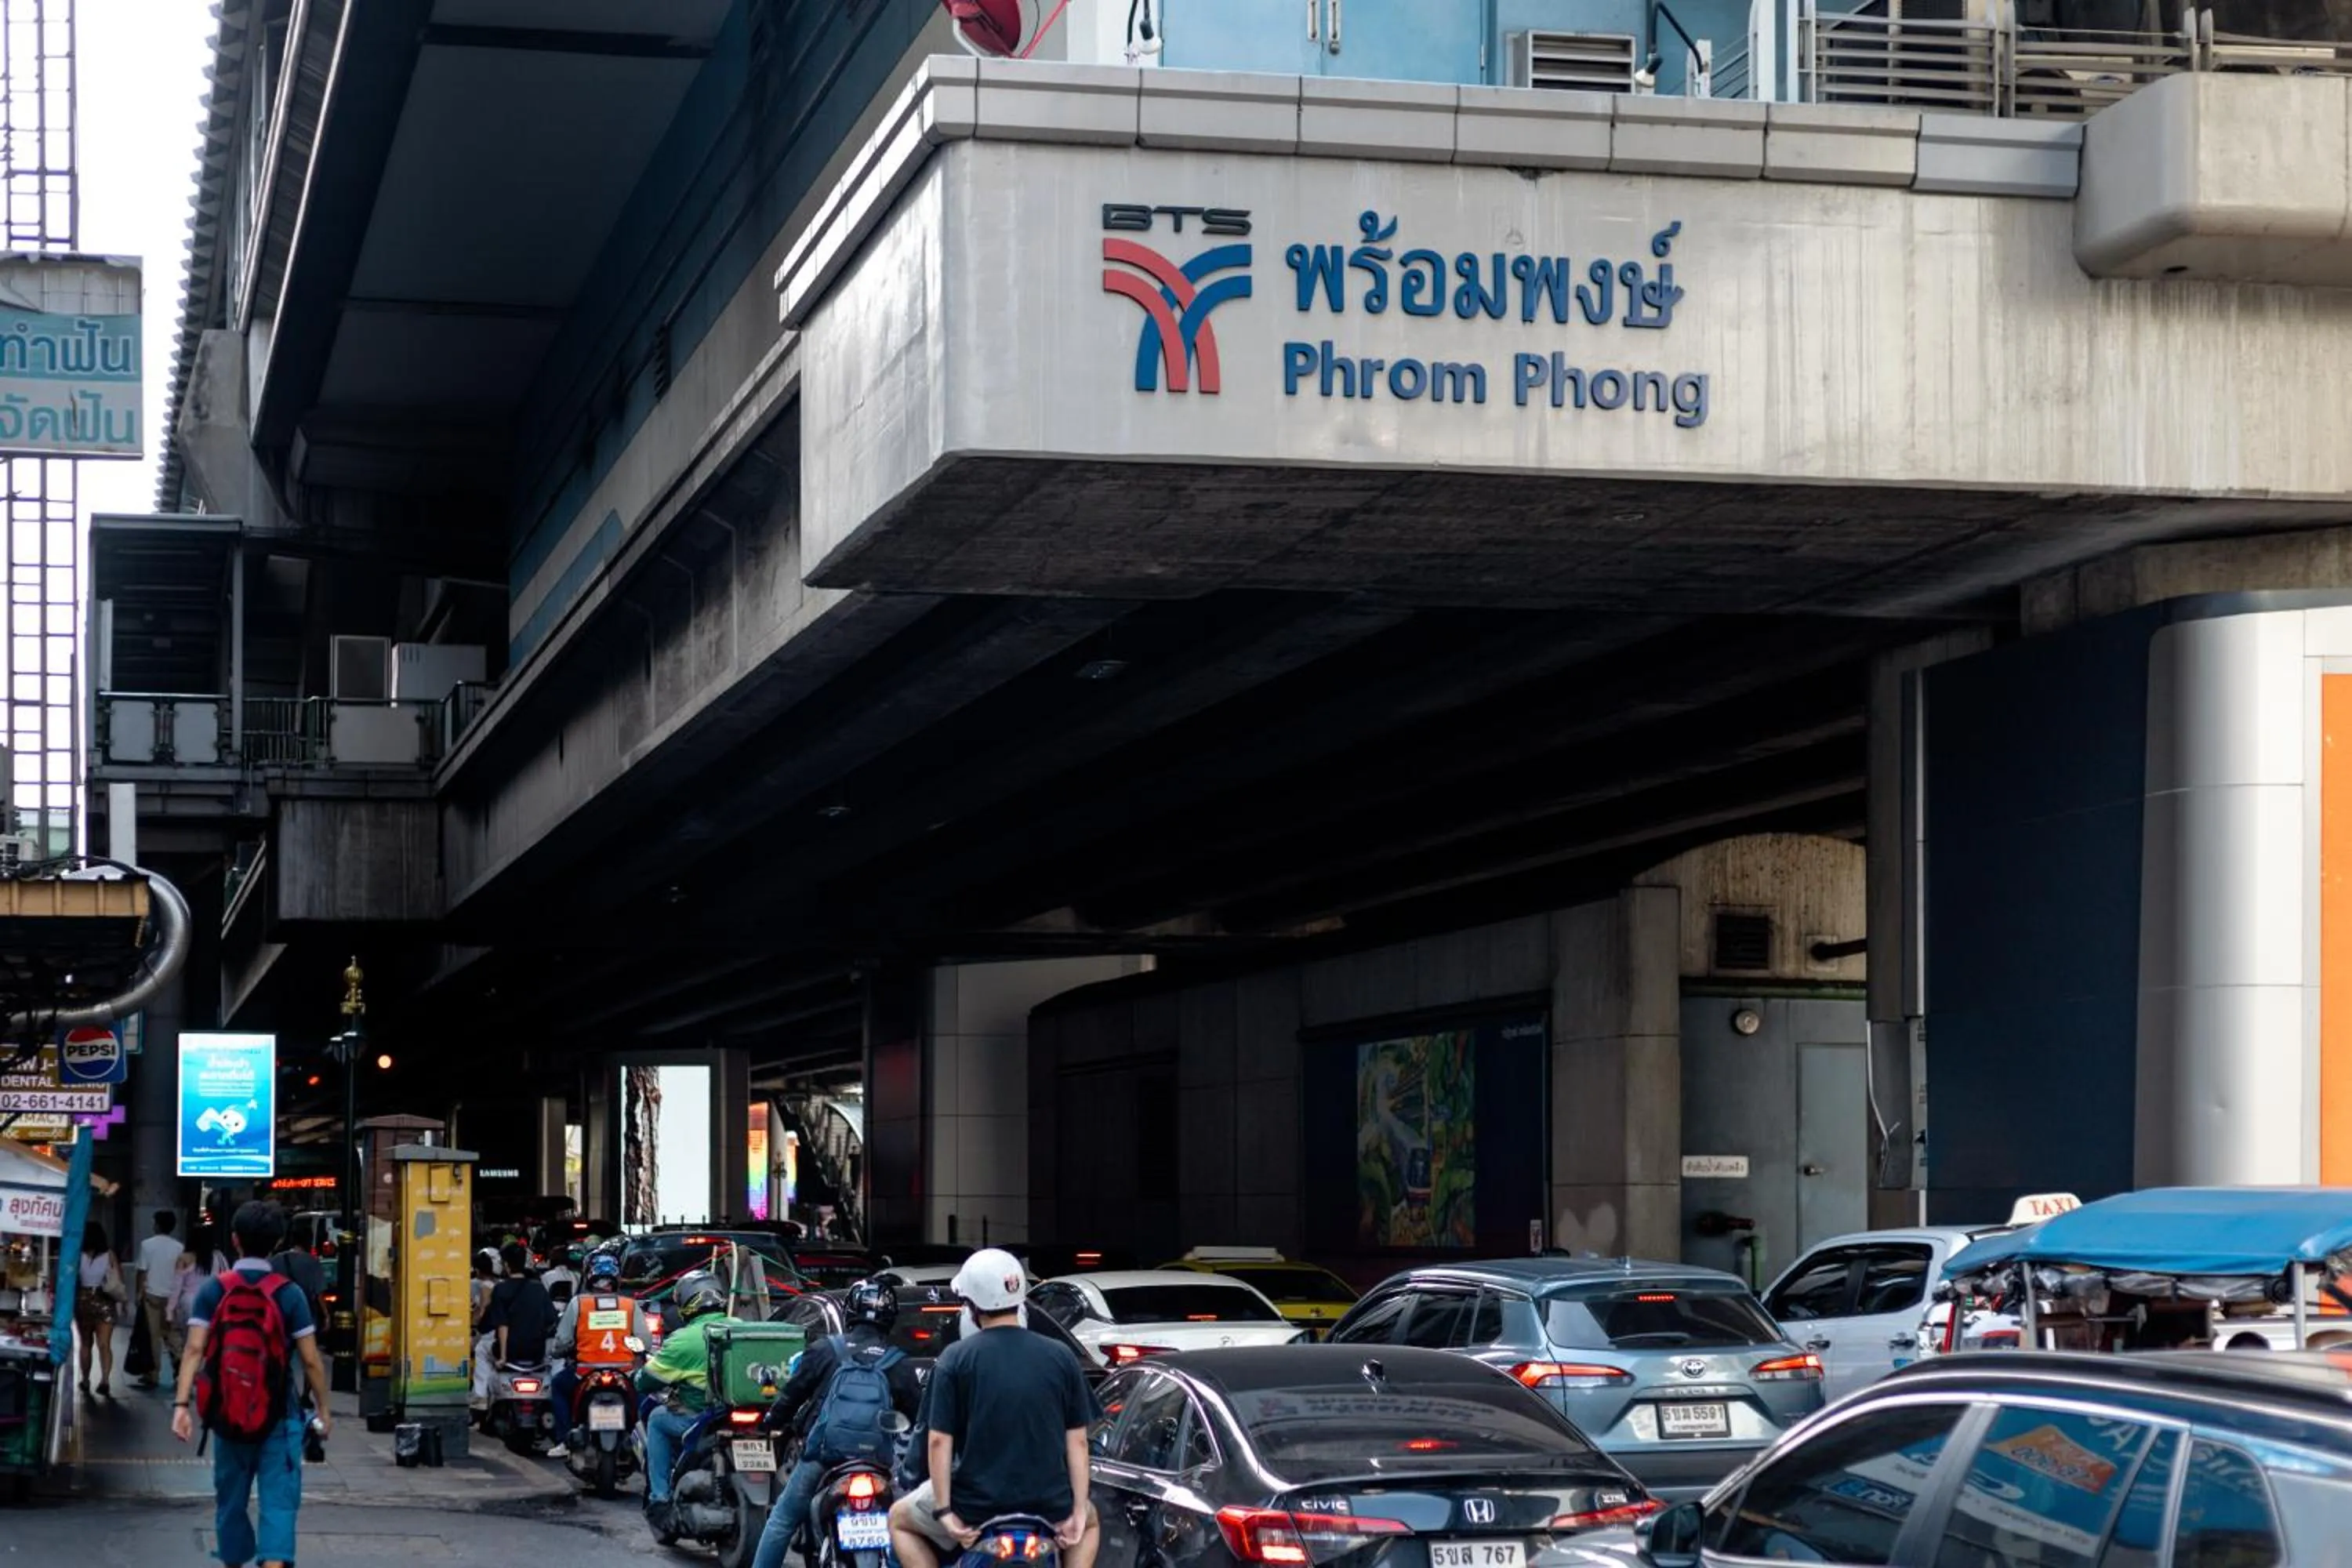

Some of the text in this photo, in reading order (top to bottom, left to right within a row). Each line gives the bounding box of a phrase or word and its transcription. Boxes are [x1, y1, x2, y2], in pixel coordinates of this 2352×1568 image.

[1102, 203, 1252, 235] BTS
[1285, 210, 1685, 328] พร้อมพงษ์
[1283, 340, 1710, 428] Phrom Phong
[67, 1044, 116, 1057] PEPSI
[1, 1076, 56, 1088] DENTAL
[1, 1094, 105, 1109] 02-661-4141
[2029, 1197, 2074, 1215] TAXI
[600, 1330, 617, 1354] 4
[1301, 1499, 1348, 1510] CIVIC
[1483, 1546, 1516, 1565] 767
